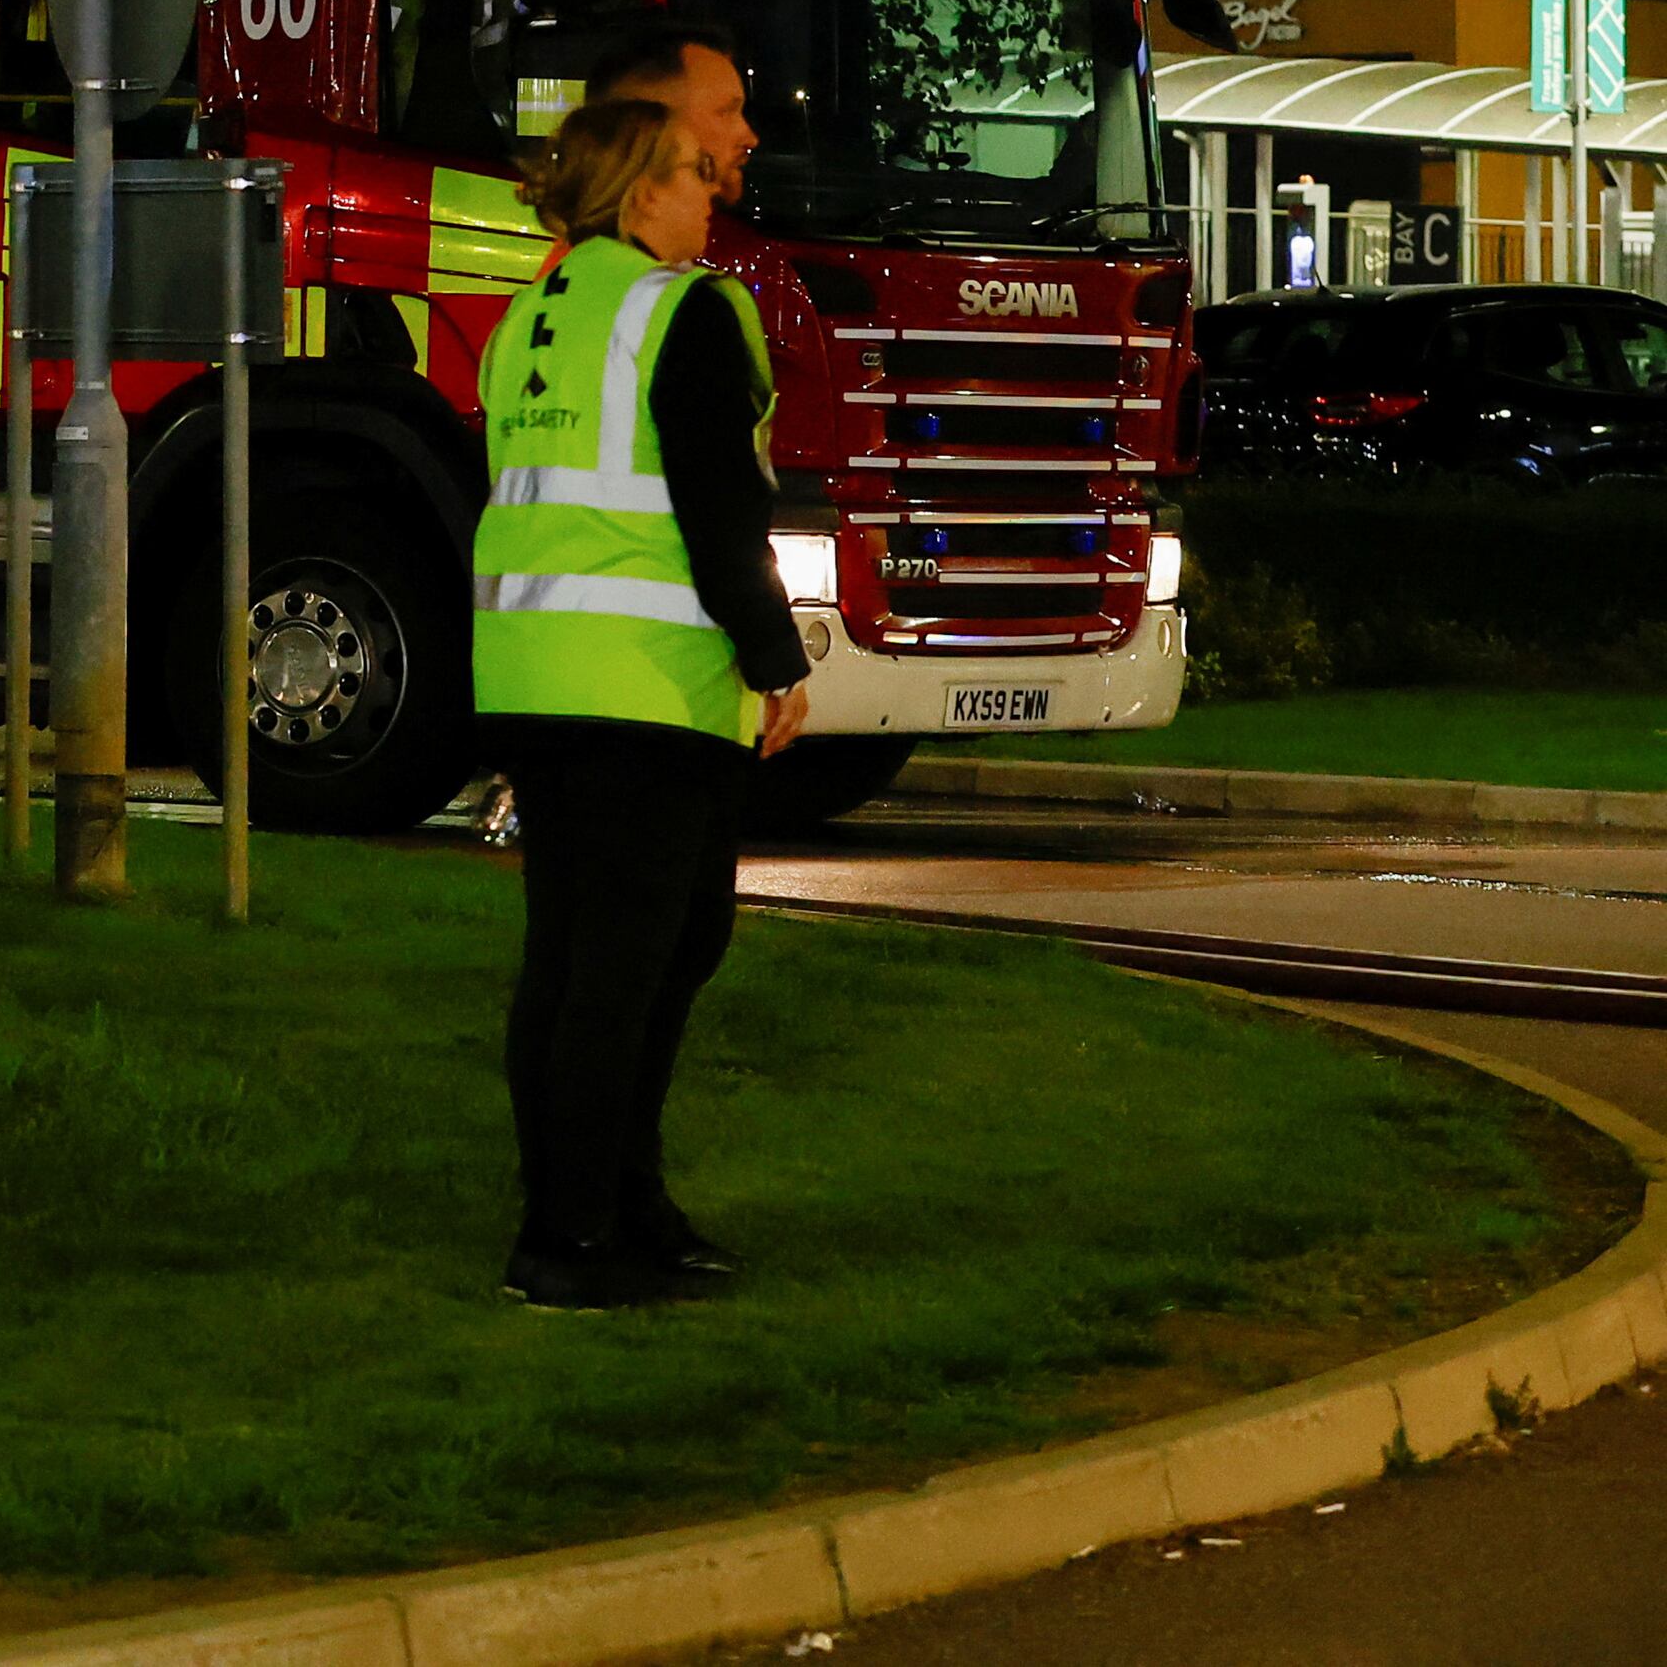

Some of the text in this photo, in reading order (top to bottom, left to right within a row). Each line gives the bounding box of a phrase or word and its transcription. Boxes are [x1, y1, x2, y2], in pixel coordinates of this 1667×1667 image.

[1394, 211, 1415, 265] BAY
[1423, 212, 1451, 266] C
[958, 279, 1079, 318] SCANIA
[881, 558, 938, 580] P 270
[954, 689, 1049, 722] KX59 EWN
